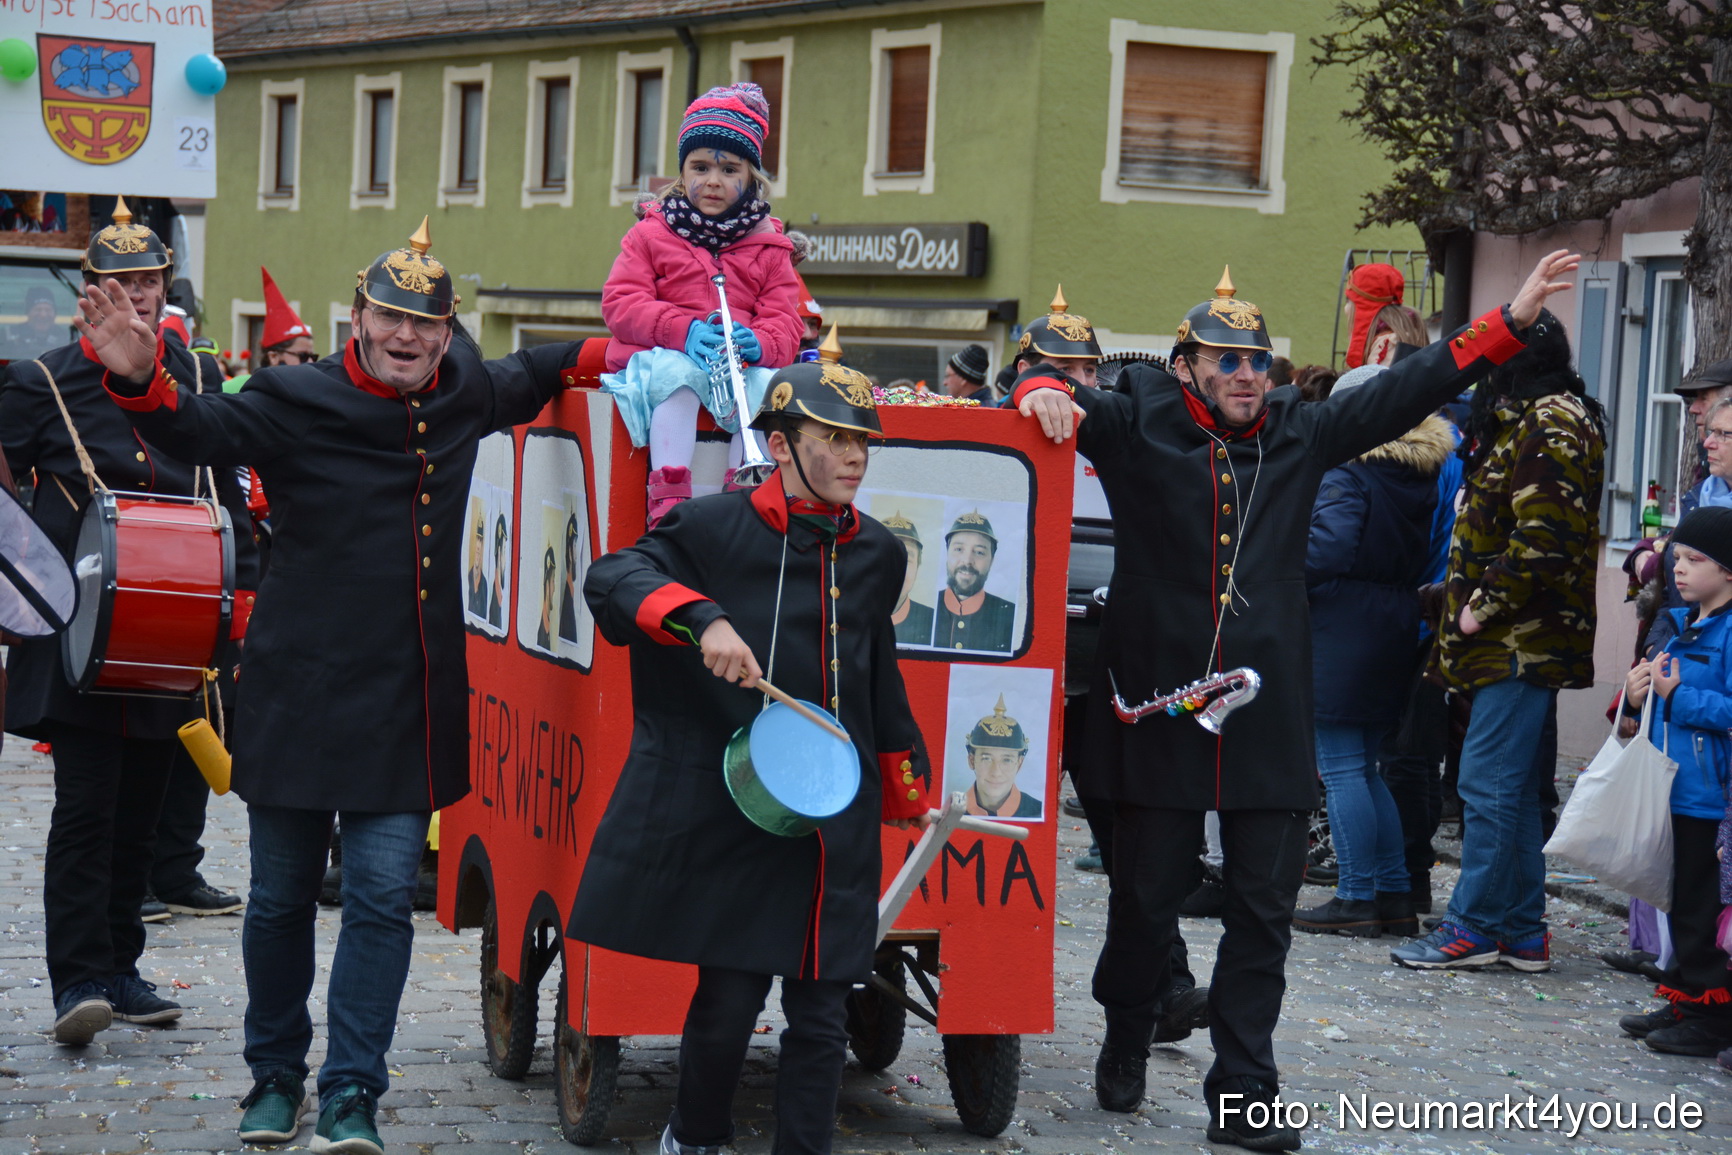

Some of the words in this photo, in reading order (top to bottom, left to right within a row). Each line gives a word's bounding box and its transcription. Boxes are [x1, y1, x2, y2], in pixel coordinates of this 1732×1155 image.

[90, 0, 207, 27] Bacham
[179, 126, 209, 152] 23
[807, 234, 897, 263] CHUHHAUS
[897, 227, 960, 270] Dess
[468, 687, 584, 857] IERWEHR
